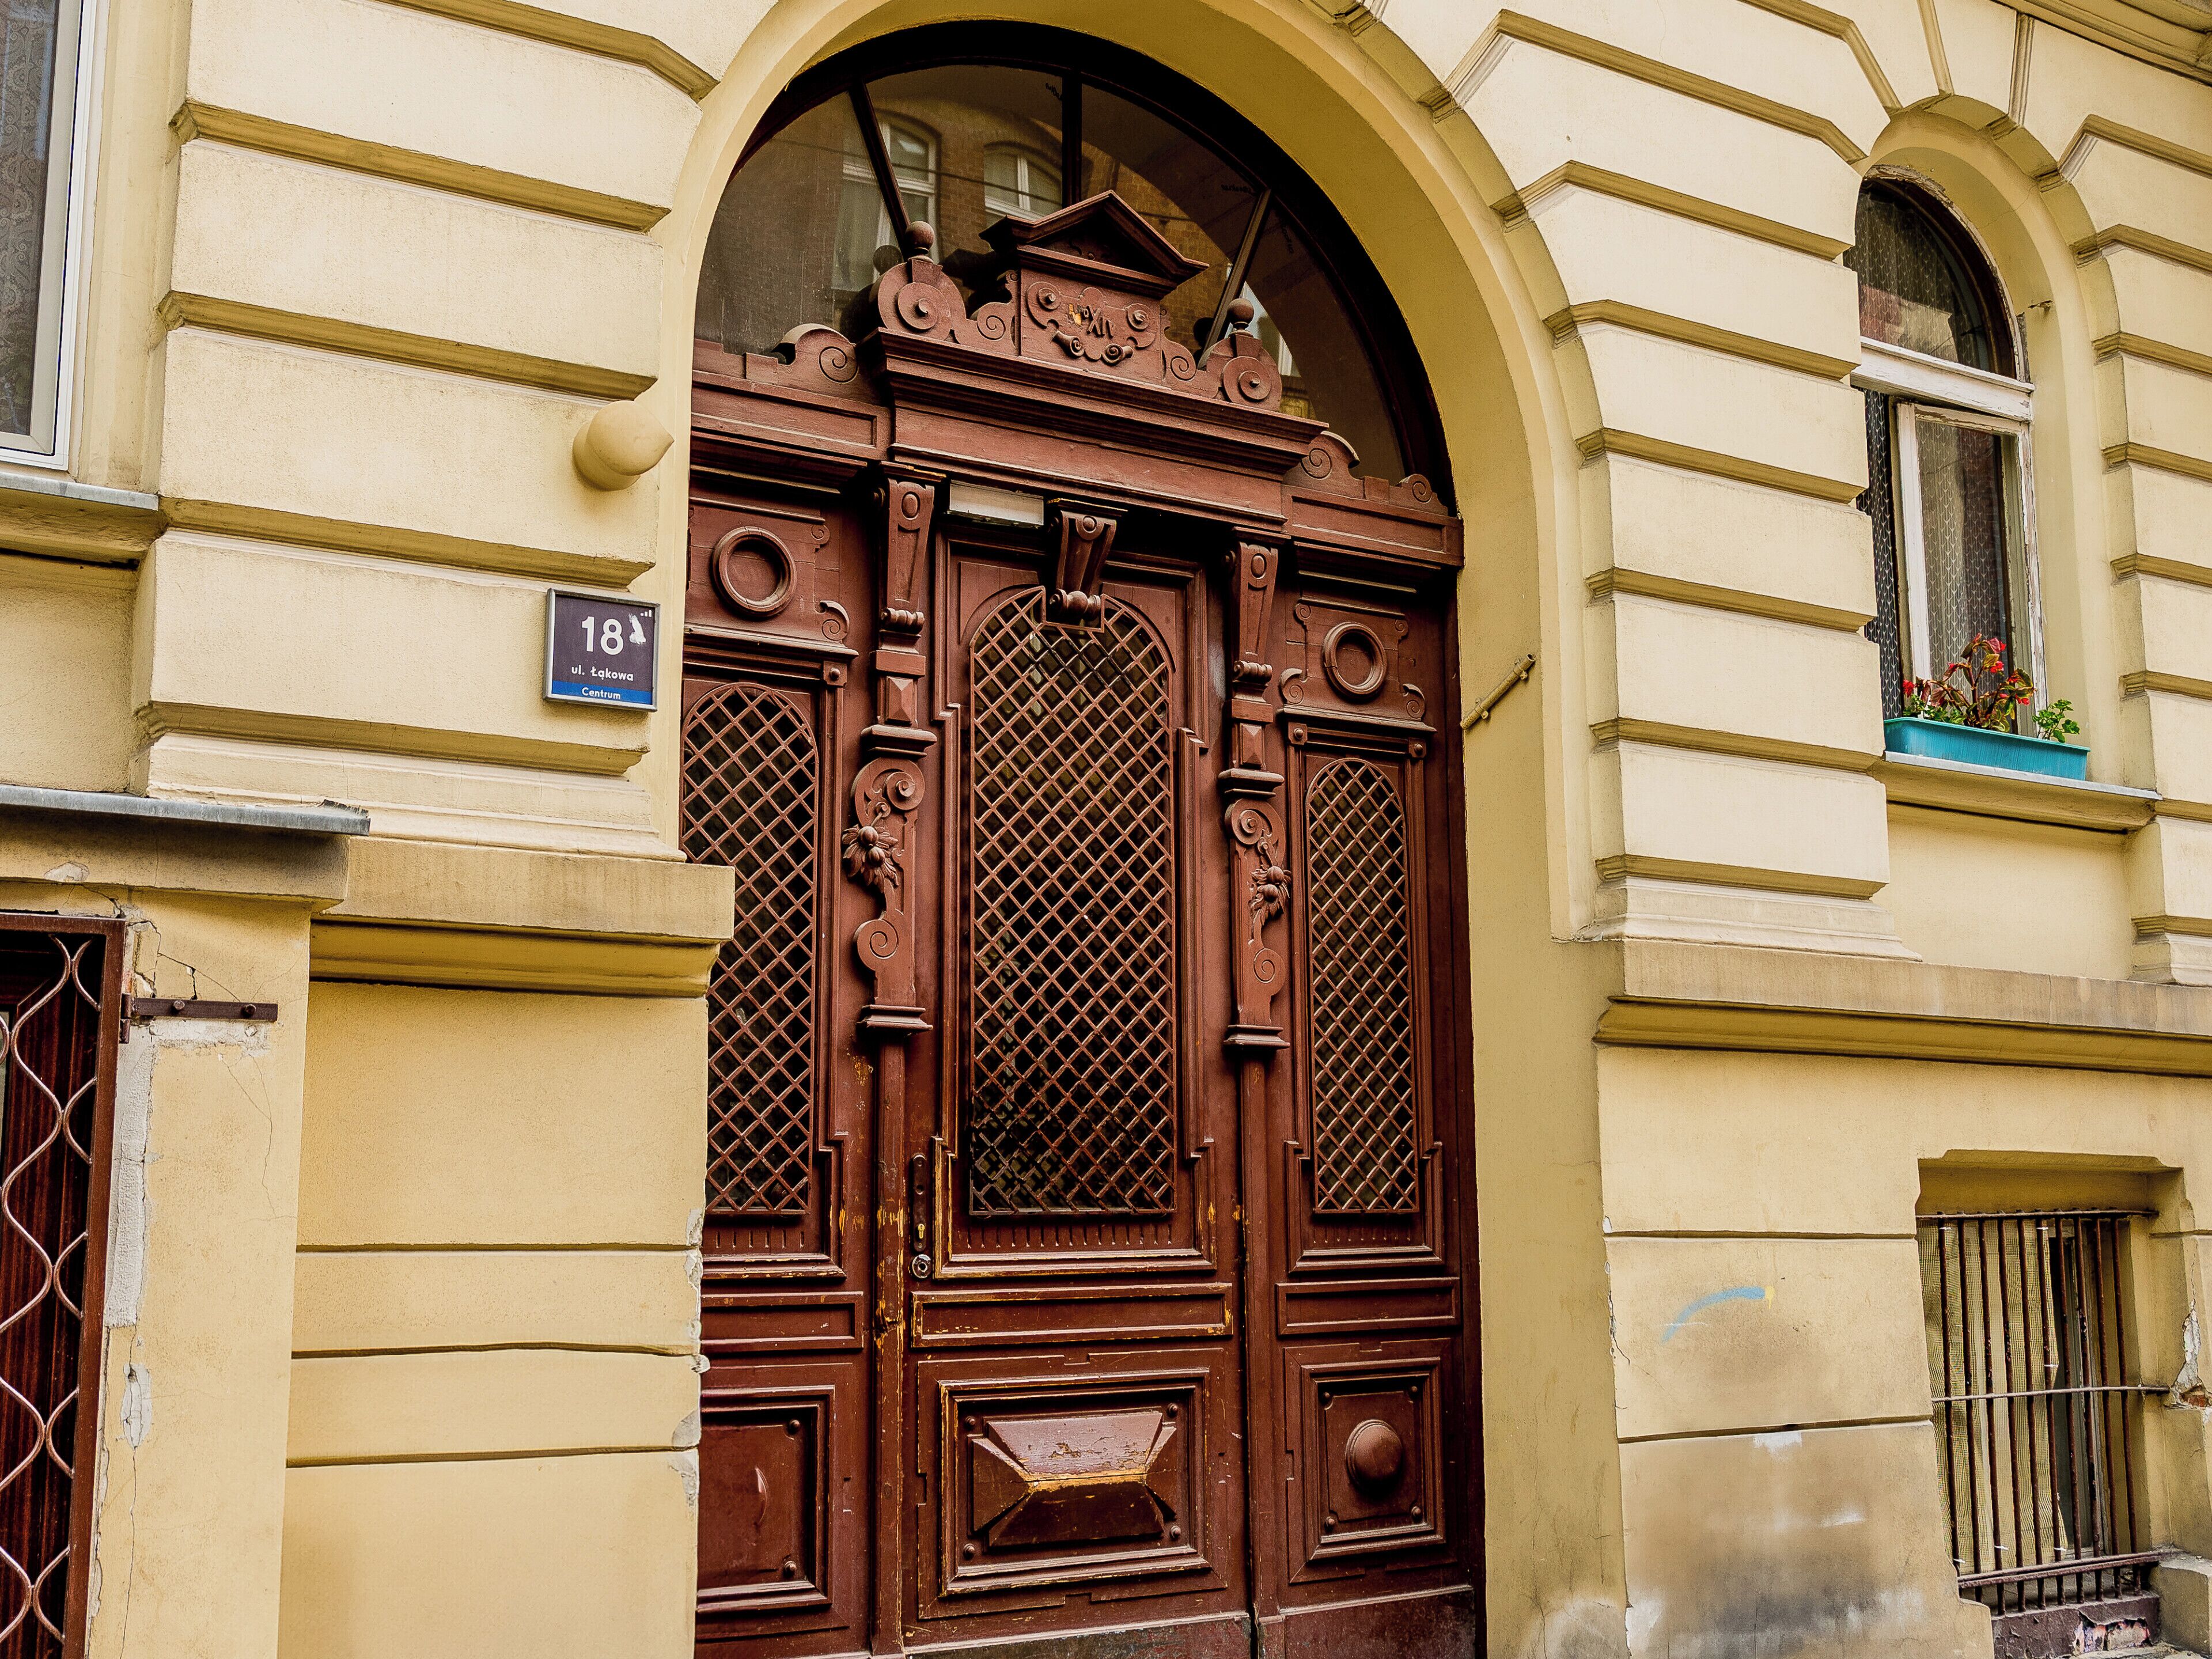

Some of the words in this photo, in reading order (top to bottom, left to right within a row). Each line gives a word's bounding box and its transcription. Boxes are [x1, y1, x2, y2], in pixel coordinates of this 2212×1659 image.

[582, 616, 624, 655] 18
[571, 665, 585, 675] ul.
[590, 666, 634, 681] Łąkowa
[582, 687, 621, 699] Centrum
